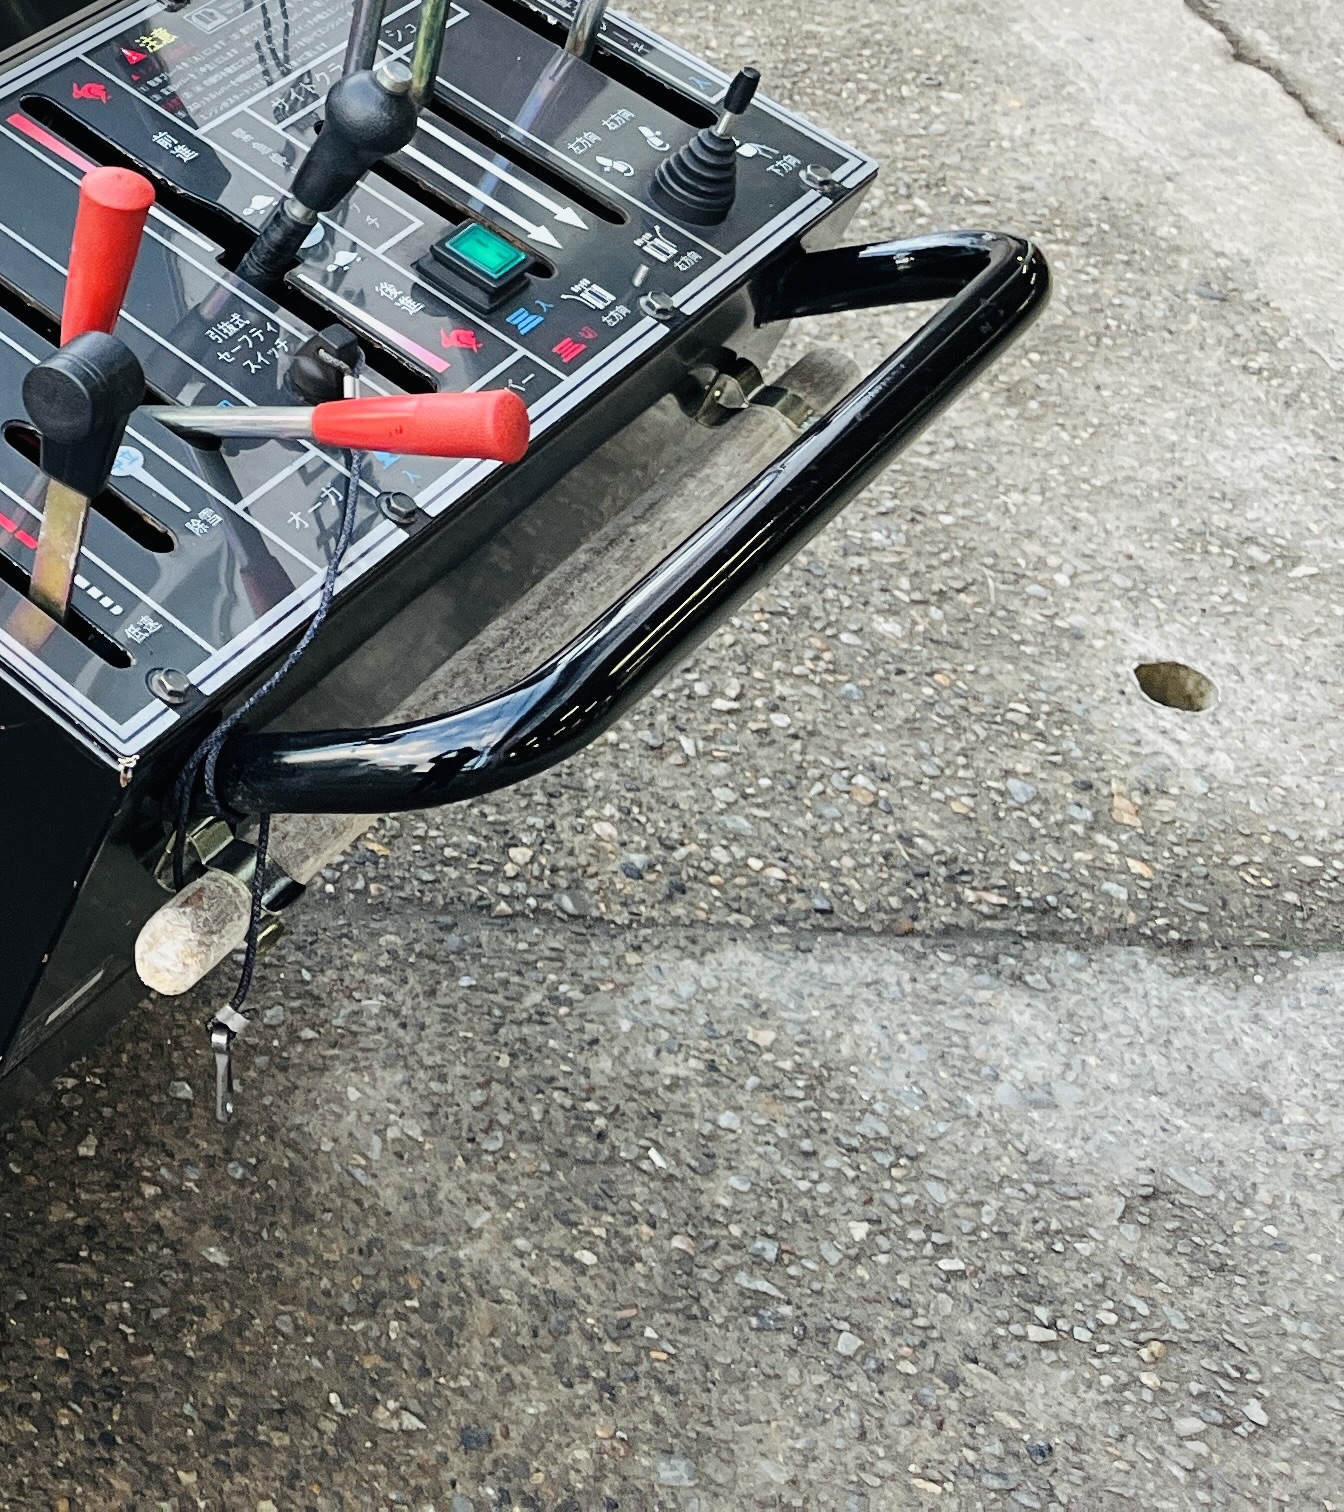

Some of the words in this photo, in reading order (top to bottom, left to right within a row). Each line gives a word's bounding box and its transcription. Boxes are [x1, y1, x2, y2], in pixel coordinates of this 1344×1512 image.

[151, 130, 200, 164] 前進
[375, 280, 427, 317] 後進
[206, 310, 252, 343] 引抜式
[216, 320, 279, 365] セーフティ
[240, 335, 291, 376] スイッチ
[184, 507, 224, 538] 除雪
[124, 614, 163, 647] 低速
